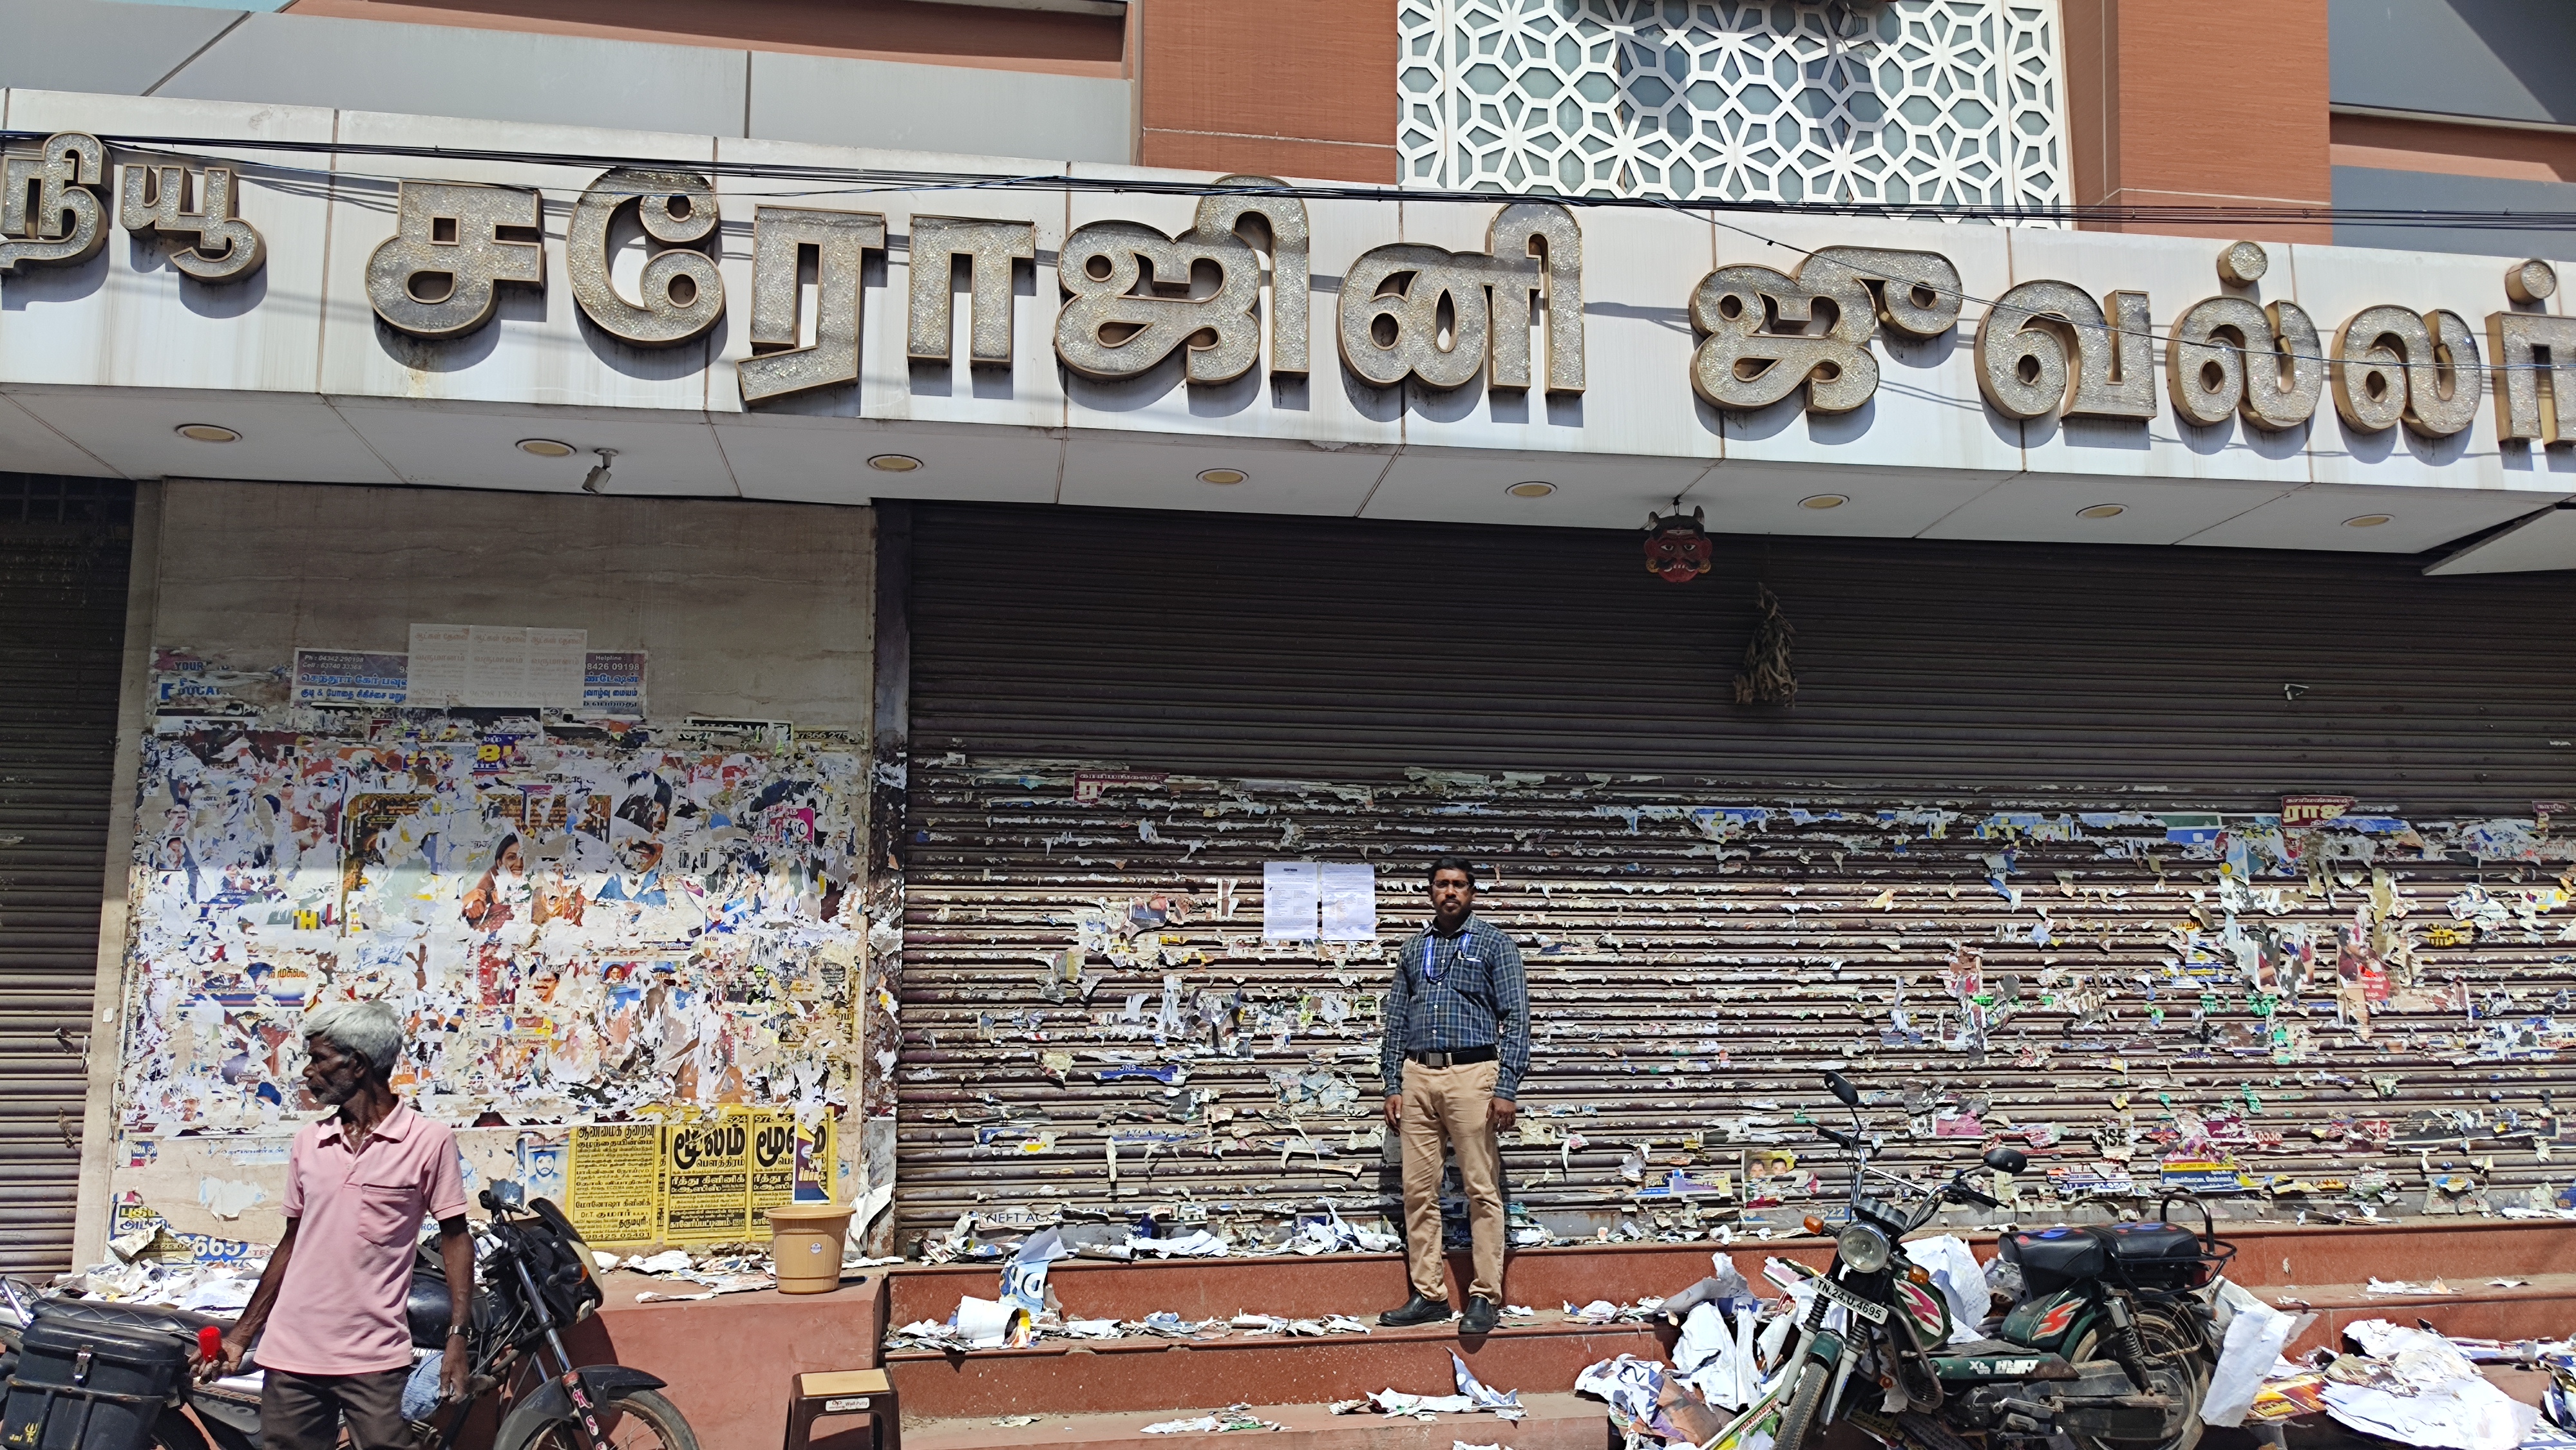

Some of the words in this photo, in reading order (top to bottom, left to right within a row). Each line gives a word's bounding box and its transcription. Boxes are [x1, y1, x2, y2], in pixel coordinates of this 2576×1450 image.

[365, 165, 1586, 402] சரோஜினி
[612, 687, 638, 697] மையம்
[702, 1174, 746, 1185] கிளினிக்
[623, 1198, 651, 1207] கிளினிக்
[1816, 1279, 1882, 1319] TN.24.U.4695
